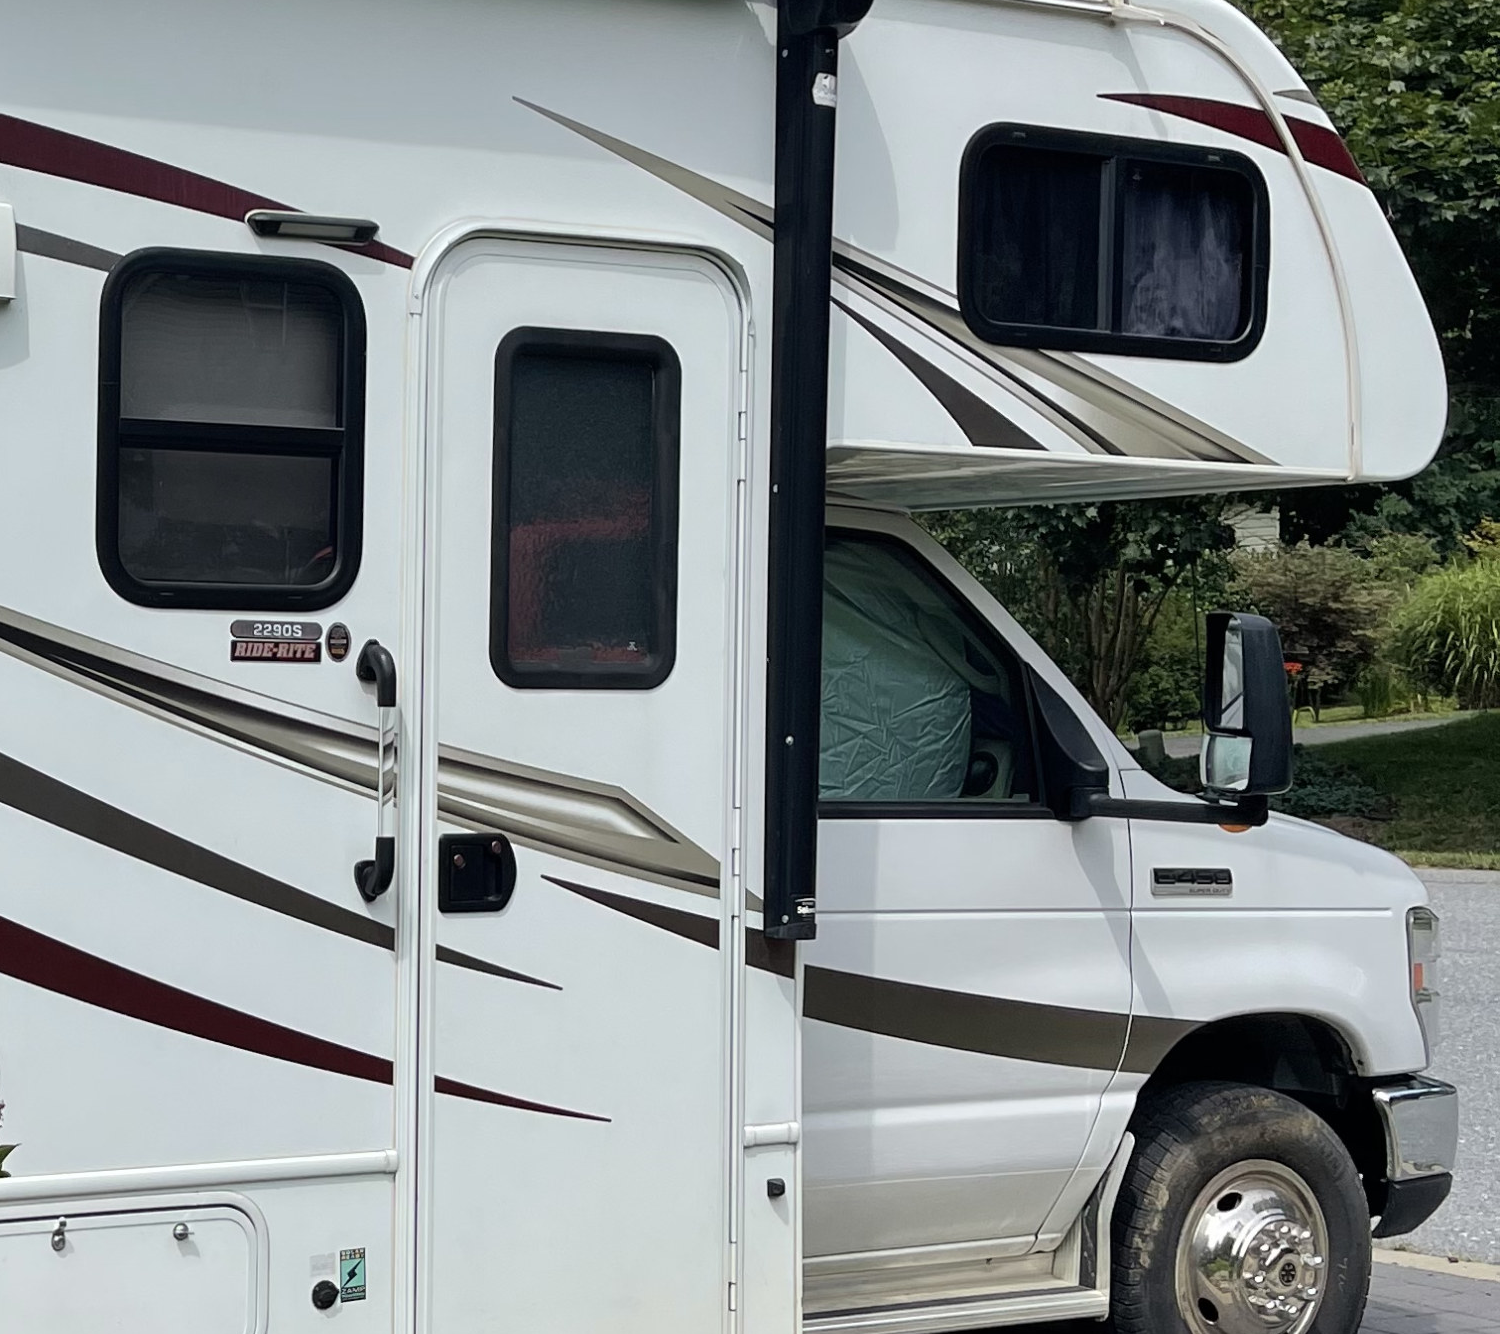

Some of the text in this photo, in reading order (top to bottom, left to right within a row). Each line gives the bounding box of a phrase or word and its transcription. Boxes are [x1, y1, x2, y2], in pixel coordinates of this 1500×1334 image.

[253, 623, 302, 637] 2290S
[234, 642, 317, 658] RIDE-RITE
[341, 1286, 366, 1294] ZAMP
